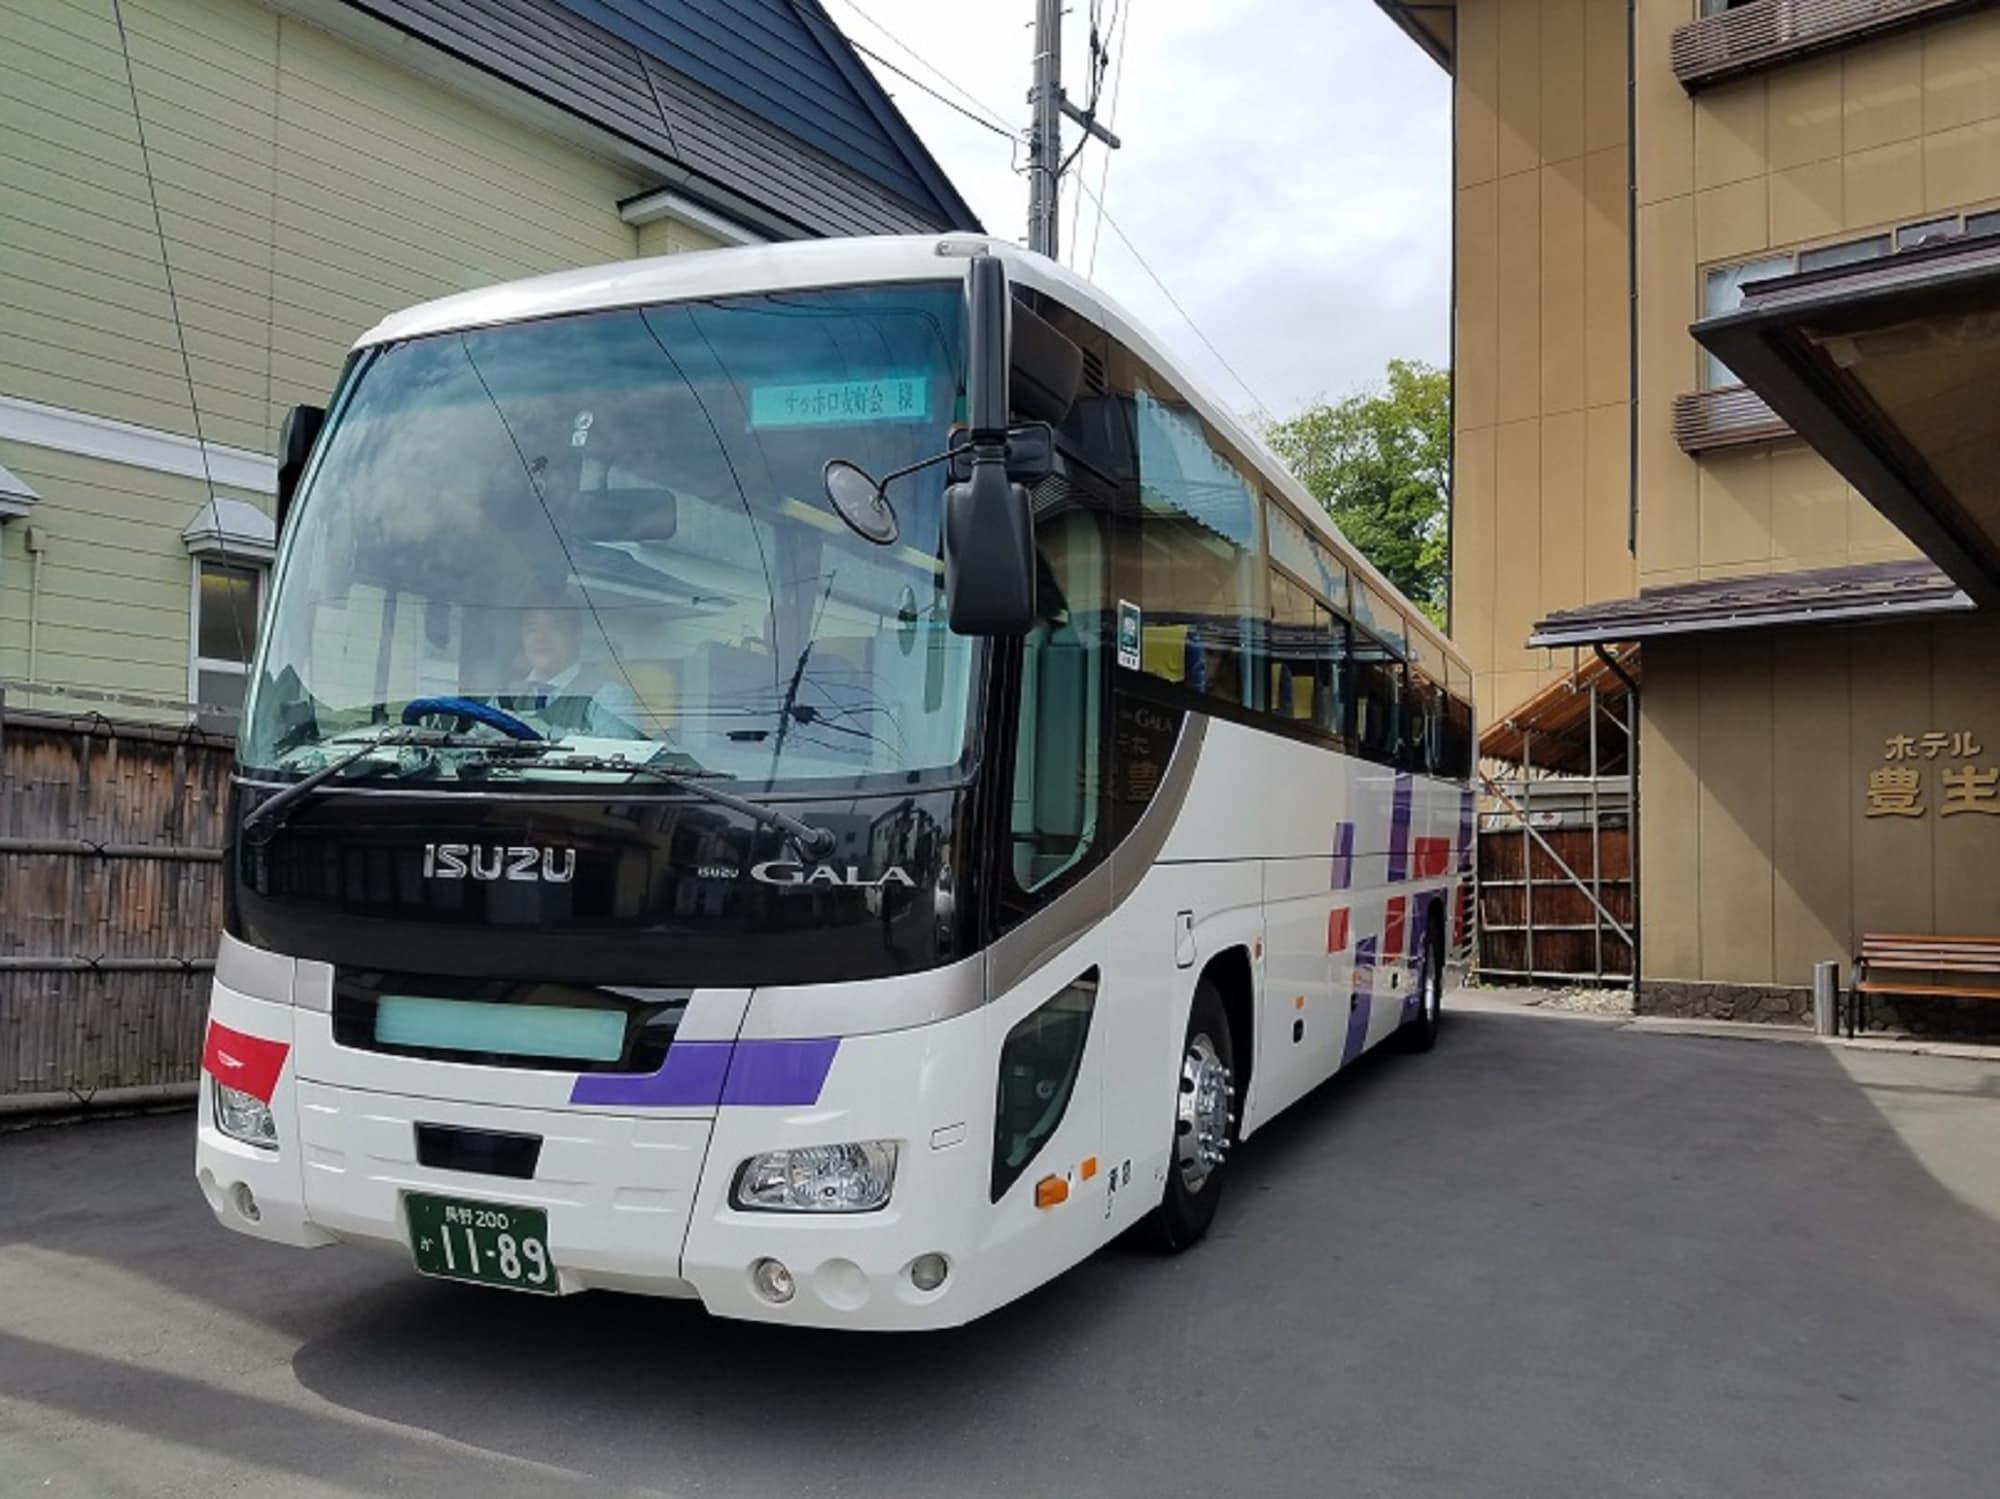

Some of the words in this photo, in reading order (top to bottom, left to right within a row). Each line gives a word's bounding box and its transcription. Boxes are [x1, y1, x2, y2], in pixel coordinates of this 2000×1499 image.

[1885, 730, 1982, 761] ホテル
[1866, 765, 2000, 817] 豊生
[423, 843, 576, 883] ISUZU
[698, 865, 739, 879] ISUZU
[750, 860, 916, 887] GALA
[441, 1225, 547, 1283] 11-89
